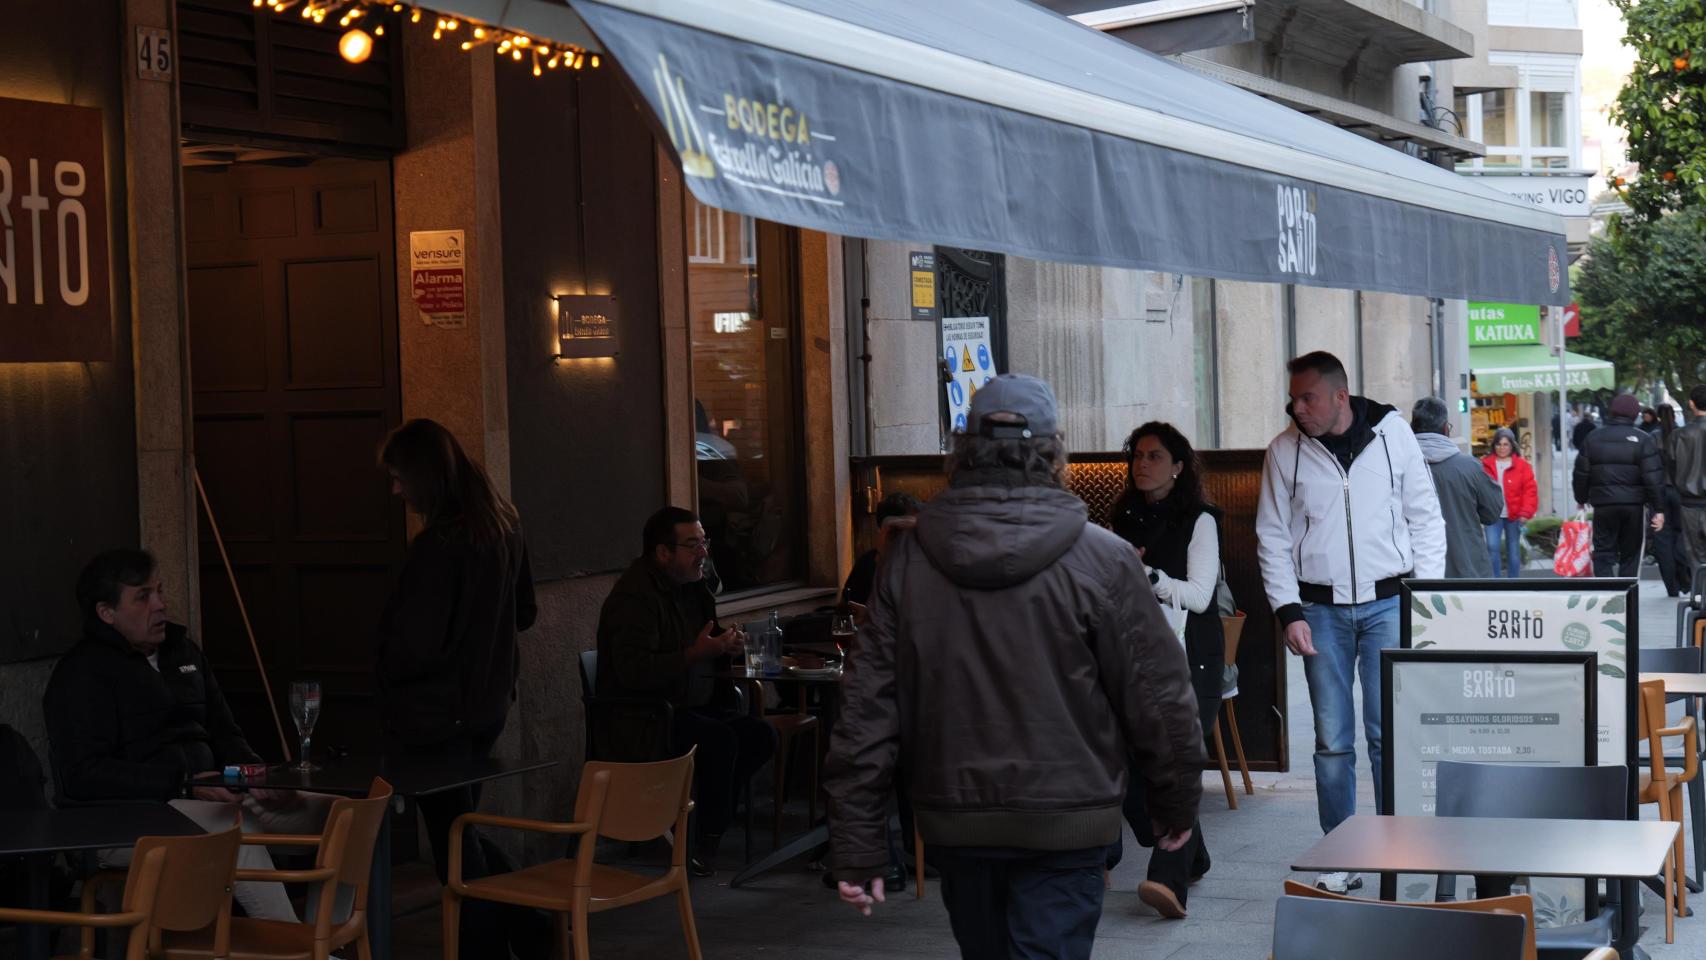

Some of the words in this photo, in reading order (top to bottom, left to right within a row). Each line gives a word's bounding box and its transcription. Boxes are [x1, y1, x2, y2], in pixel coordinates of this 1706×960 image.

[140, 36, 169, 71] 45
[724, 93, 810, 145] BODEGA
[708, 132, 769, 181] Estrella
[768, 145, 824, 193] Galicia
[1549, 188, 1586, 204] VIGO
[1277, 184, 1316, 238] PORTO
[414, 248, 462, 259] verisure
[1278, 224, 1316, 276] SANTO
[415, 271, 463, 285] Alarma
[1474, 324, 1536, 341] KATUXA
[1487, 609, 1544, 628] PORTO
[1487, 621, 1544, 639] SANTO
[1463, 670, 1515, 687] PORTO
[1463, 681, 1515, 698] SANTO
[1445, 715, 1490, 723] DESAYUNOS
[1492, 715, 1534, 723] GLORIOSOS
[1451, 745, 1475, 754] MEDIA
[1478, 745, 1513, 754] TOSTADA
